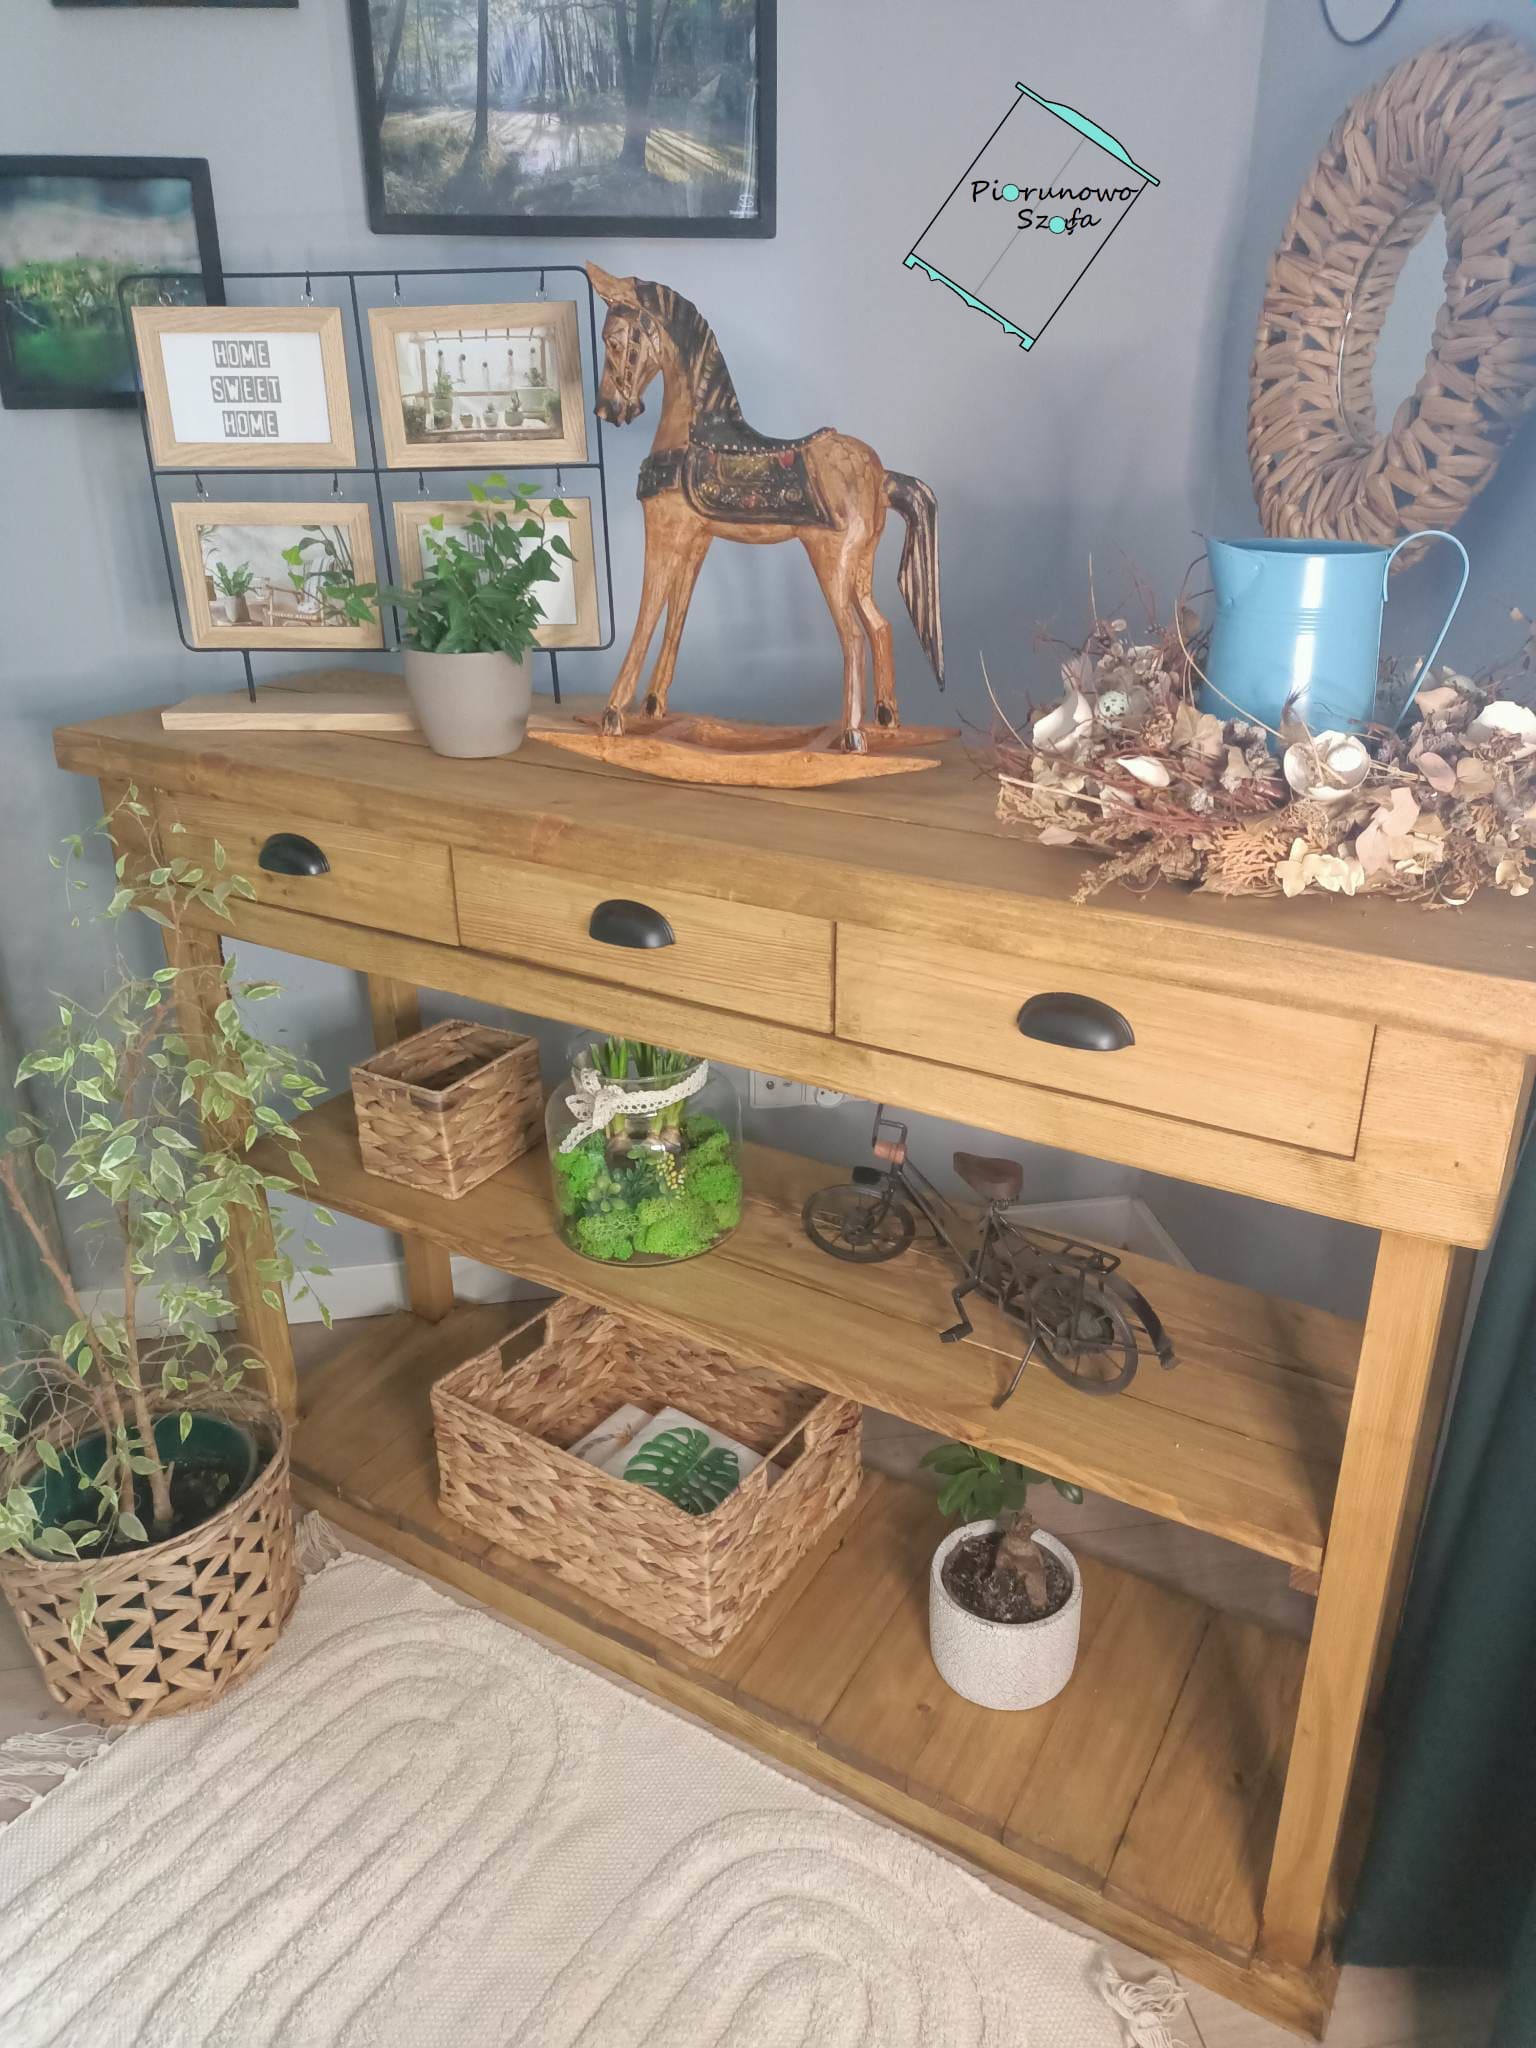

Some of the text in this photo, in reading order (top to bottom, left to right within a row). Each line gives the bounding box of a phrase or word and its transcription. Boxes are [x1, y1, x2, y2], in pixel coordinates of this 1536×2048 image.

[214, 342, 269, 367] HOME
[211, 377, 281, 402] SWEET
[223, 412, 279, 436] HOME
